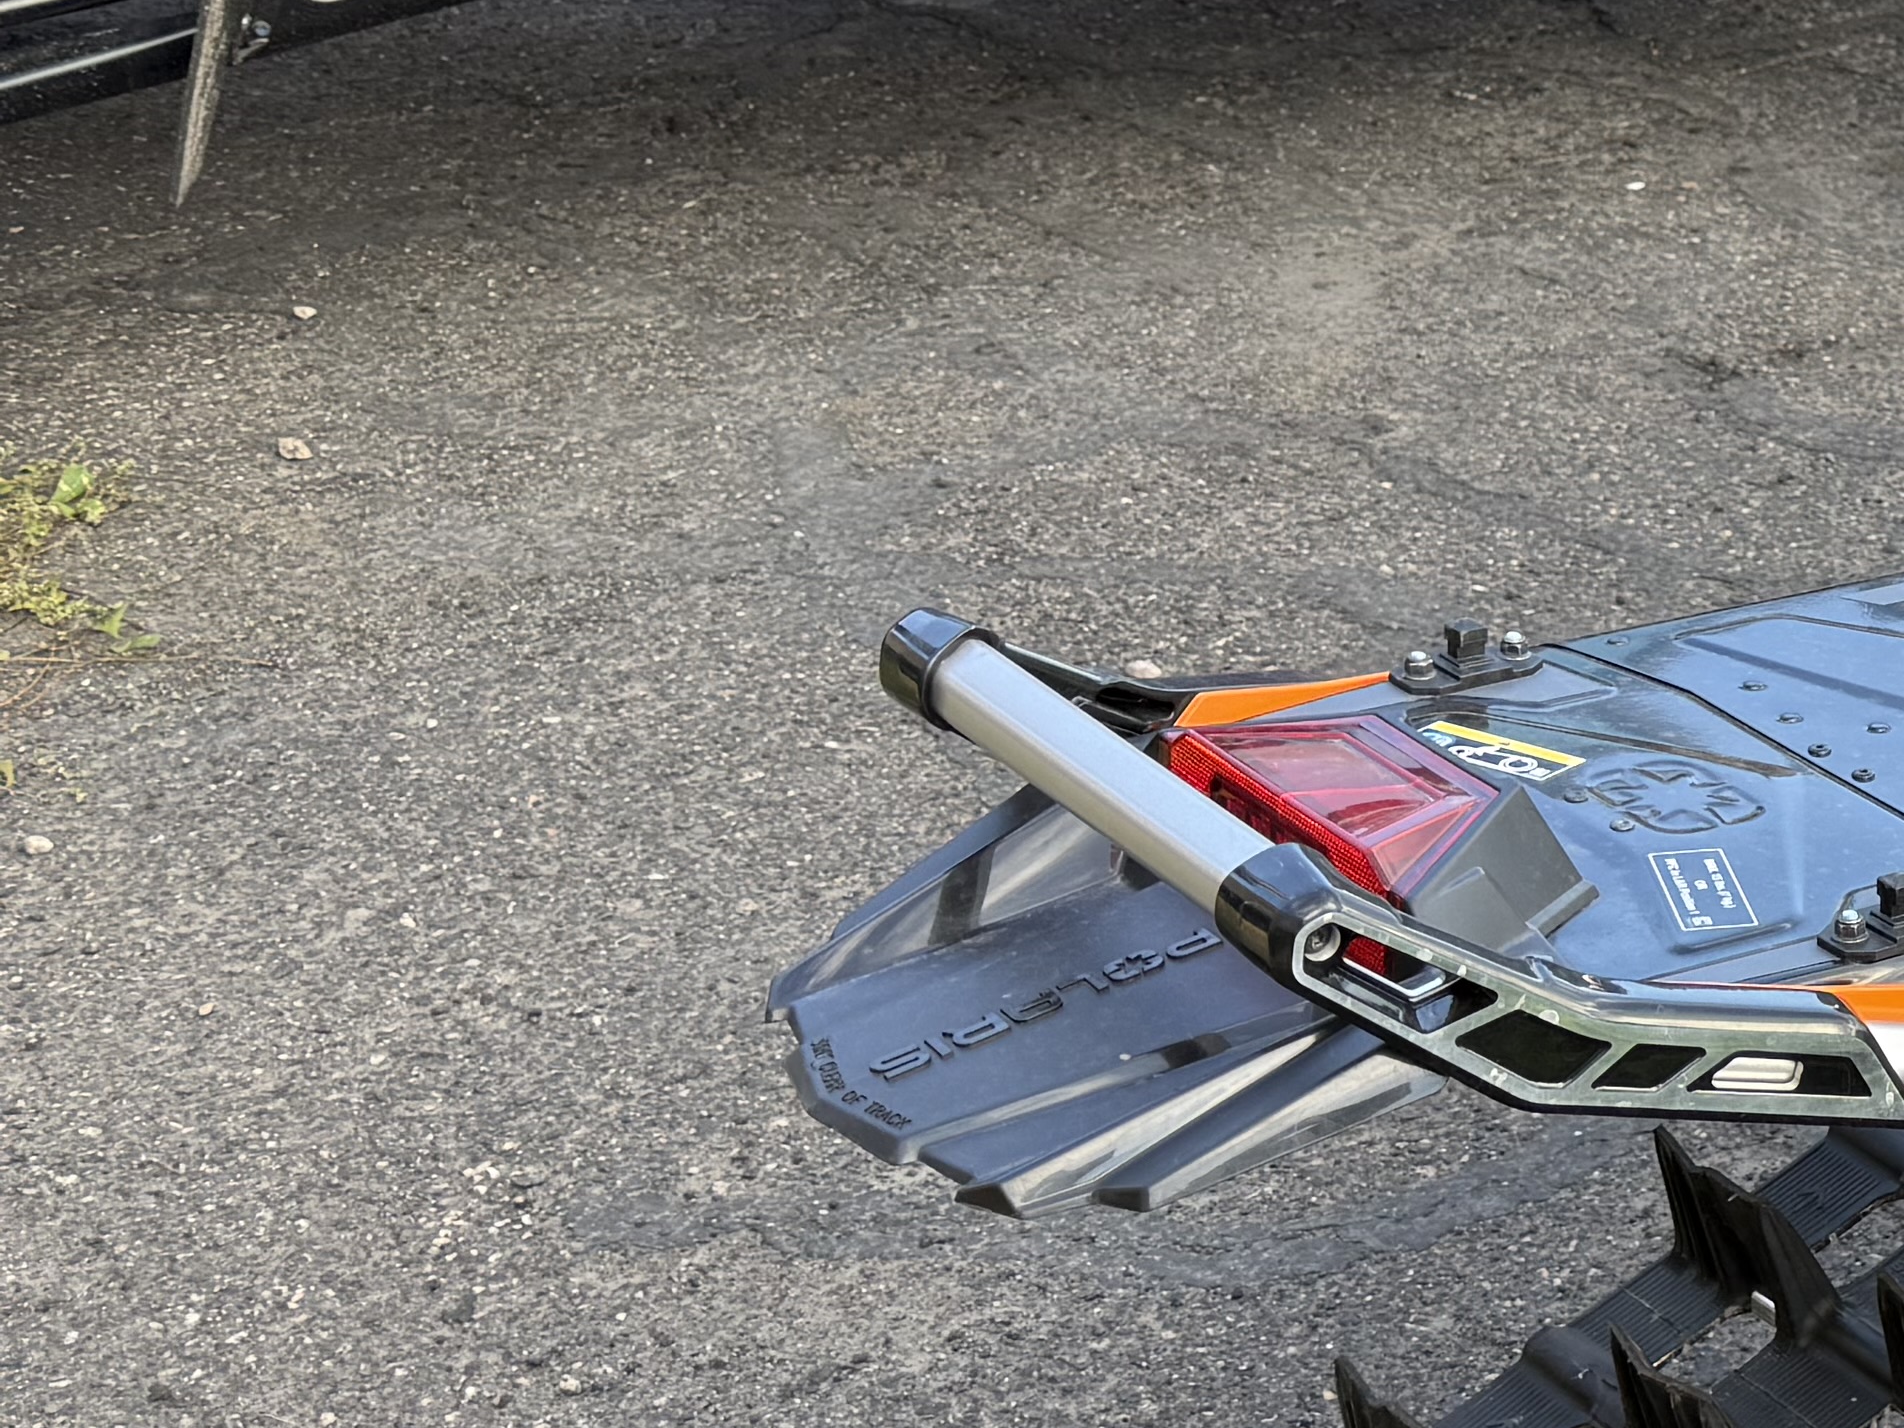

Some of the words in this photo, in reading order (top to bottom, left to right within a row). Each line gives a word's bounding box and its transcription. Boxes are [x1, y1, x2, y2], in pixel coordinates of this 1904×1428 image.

[868, 927, 1222, 1081] POLARIS
[841, 1090, 868, 1106] OF
[863, 1100, 912, 1130] TRACK
